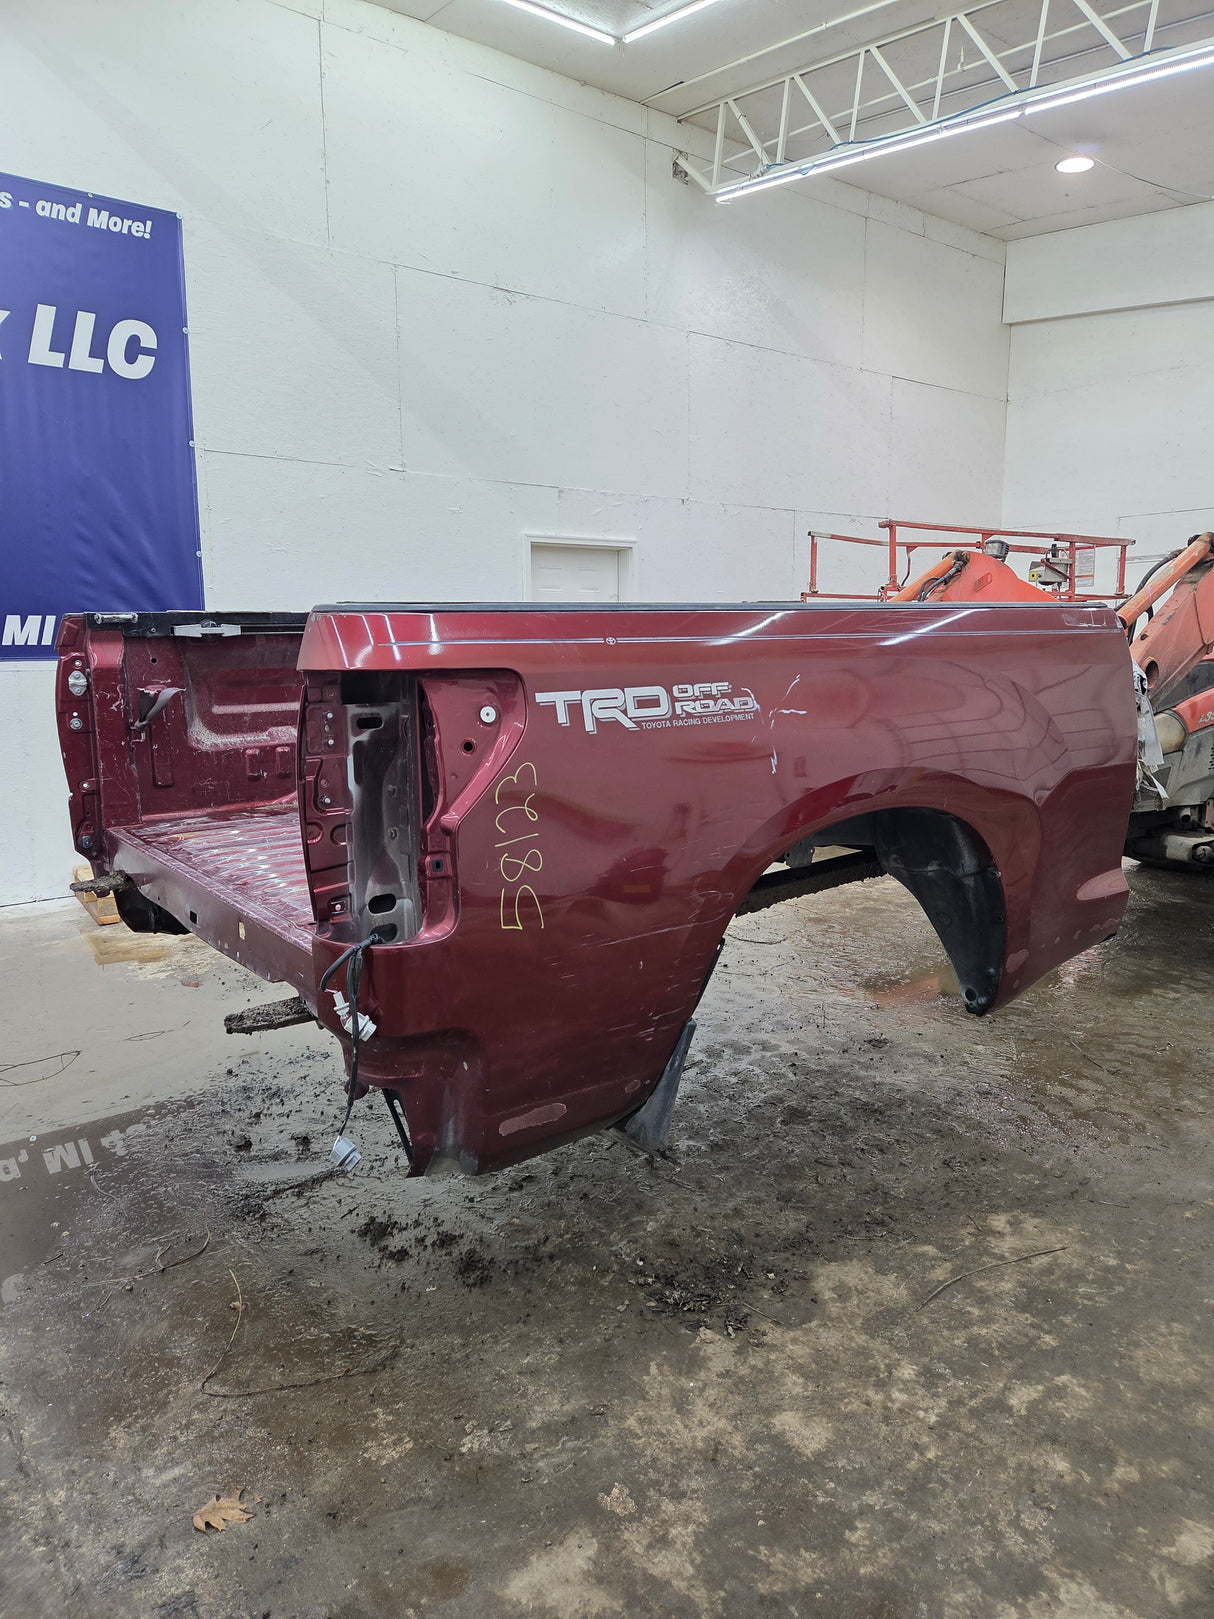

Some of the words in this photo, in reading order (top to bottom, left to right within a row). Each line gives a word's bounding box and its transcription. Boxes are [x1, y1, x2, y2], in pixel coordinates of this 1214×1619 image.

[35, 199, 83, 224] and
[86, 207, 153, 239] More!
[27, 303, 158, 380] LLC
[1, 614, 57, 646] MI
[672, 681, 733, 700] OFF
[674, 696, 759, 717] ROAD
[535, 685, 673, 735] TRD
[641, 721, 671, 730] TOYOTA
[672, 718, 701, 726] RACING
[702, 713, 755, 724] DEVELOPMENT
[494, 761, 546, 931] 58123
